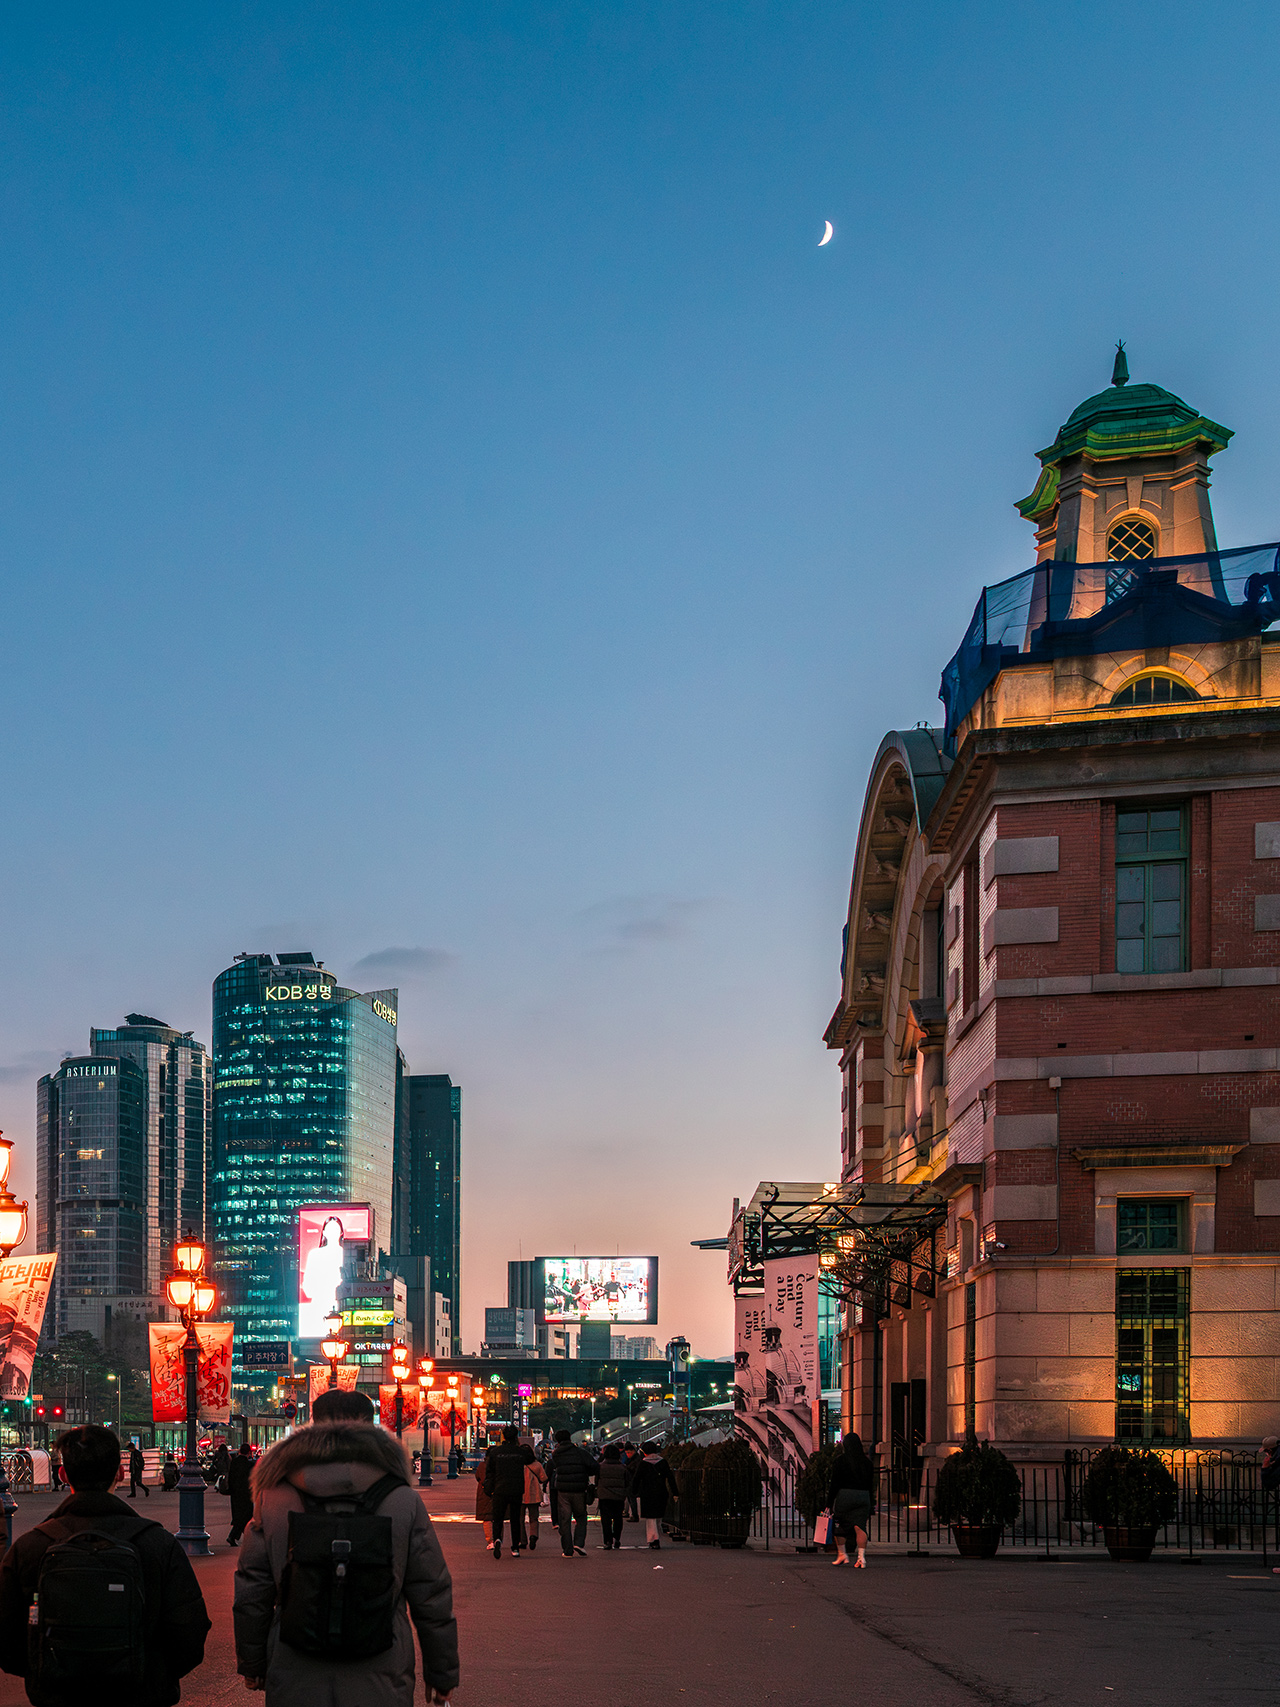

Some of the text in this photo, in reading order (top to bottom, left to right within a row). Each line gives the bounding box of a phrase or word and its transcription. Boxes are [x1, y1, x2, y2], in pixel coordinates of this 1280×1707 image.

[66, 1066, 117, 1077] ASTERIUM
[806, 1273, 815, 1282] A
[775, 1276, 786, 1314] a Day
[787, 1275, 795, 1301] and
[793, 1273, 806, 1330] Century
[744, 1321, 752, 1341] Day
[255, 1352, 278, 1362] 주차장
